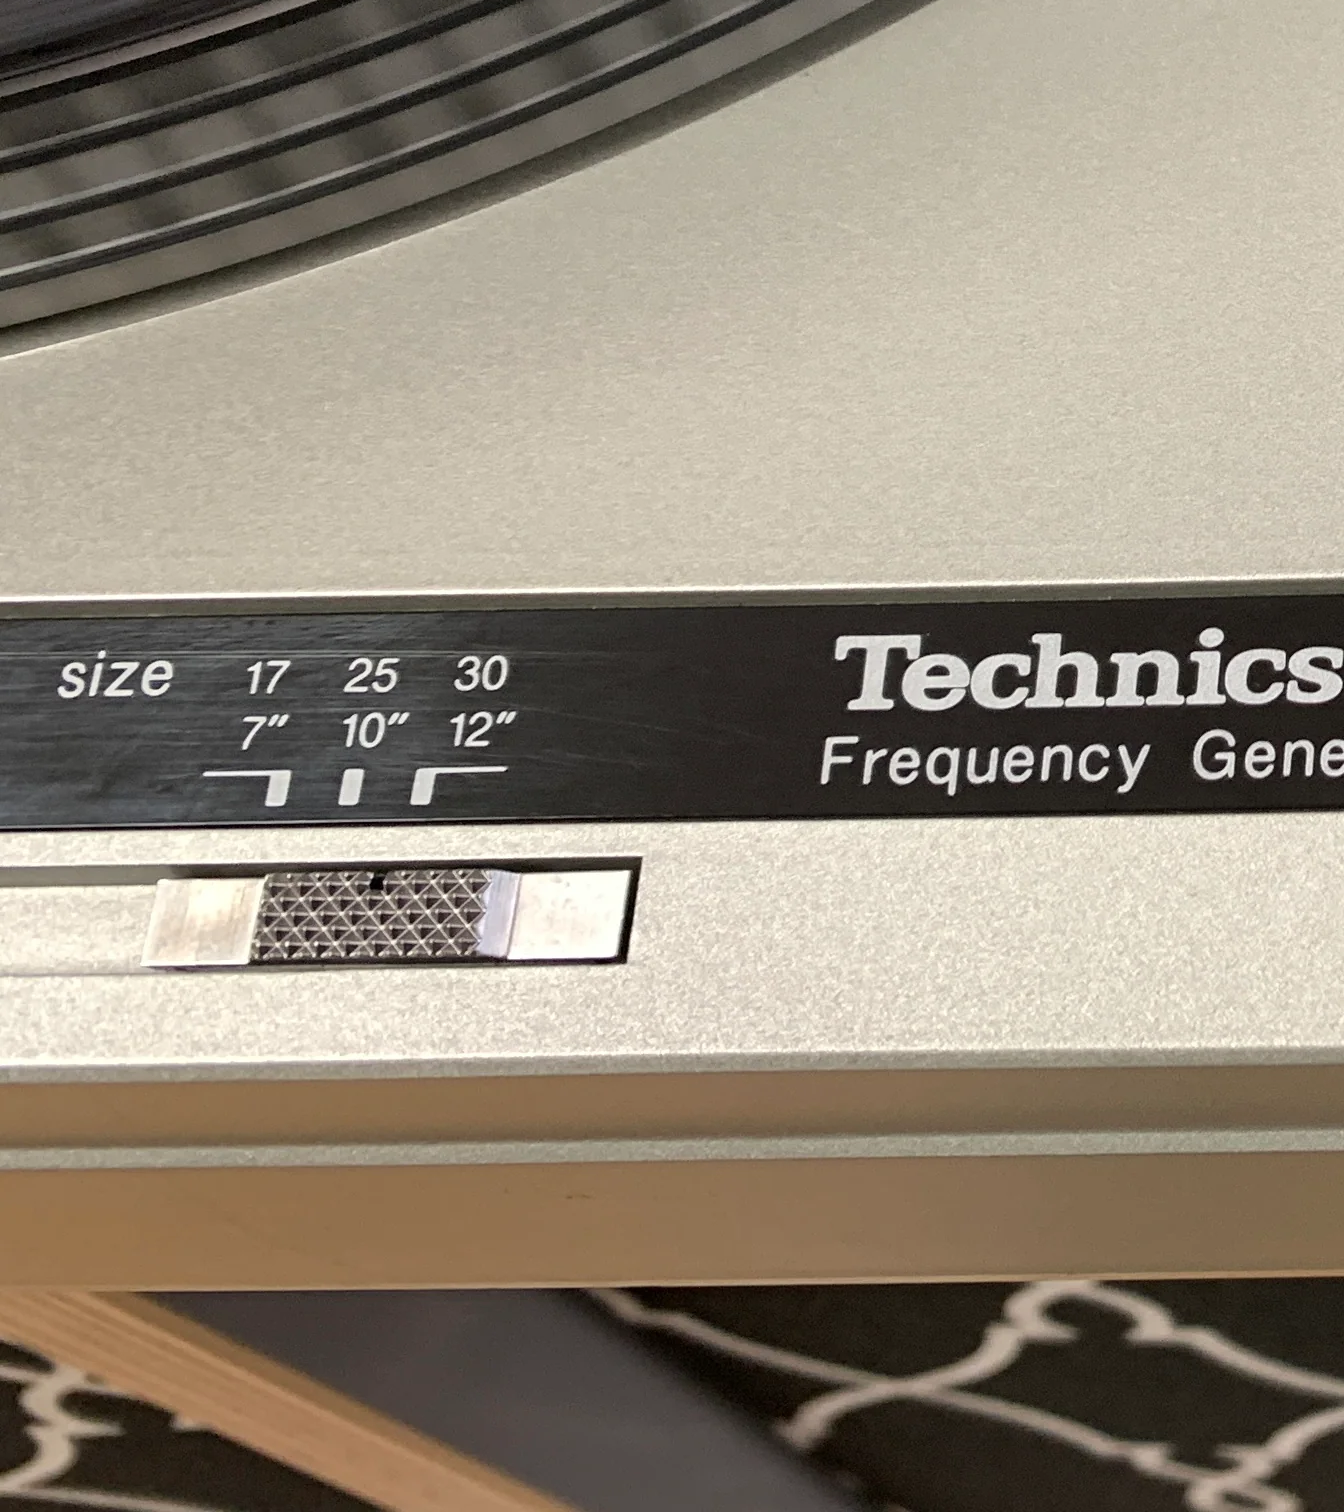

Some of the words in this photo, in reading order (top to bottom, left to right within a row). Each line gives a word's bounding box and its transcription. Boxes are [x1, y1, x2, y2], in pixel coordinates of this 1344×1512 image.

[57, 650, 175, 699] size
[246, 659, 291, 695] 17
[342, 657, 399, 694] 25
[453, 654, 510, 692] 30
[820, 735, 1151, 797] Frequency
